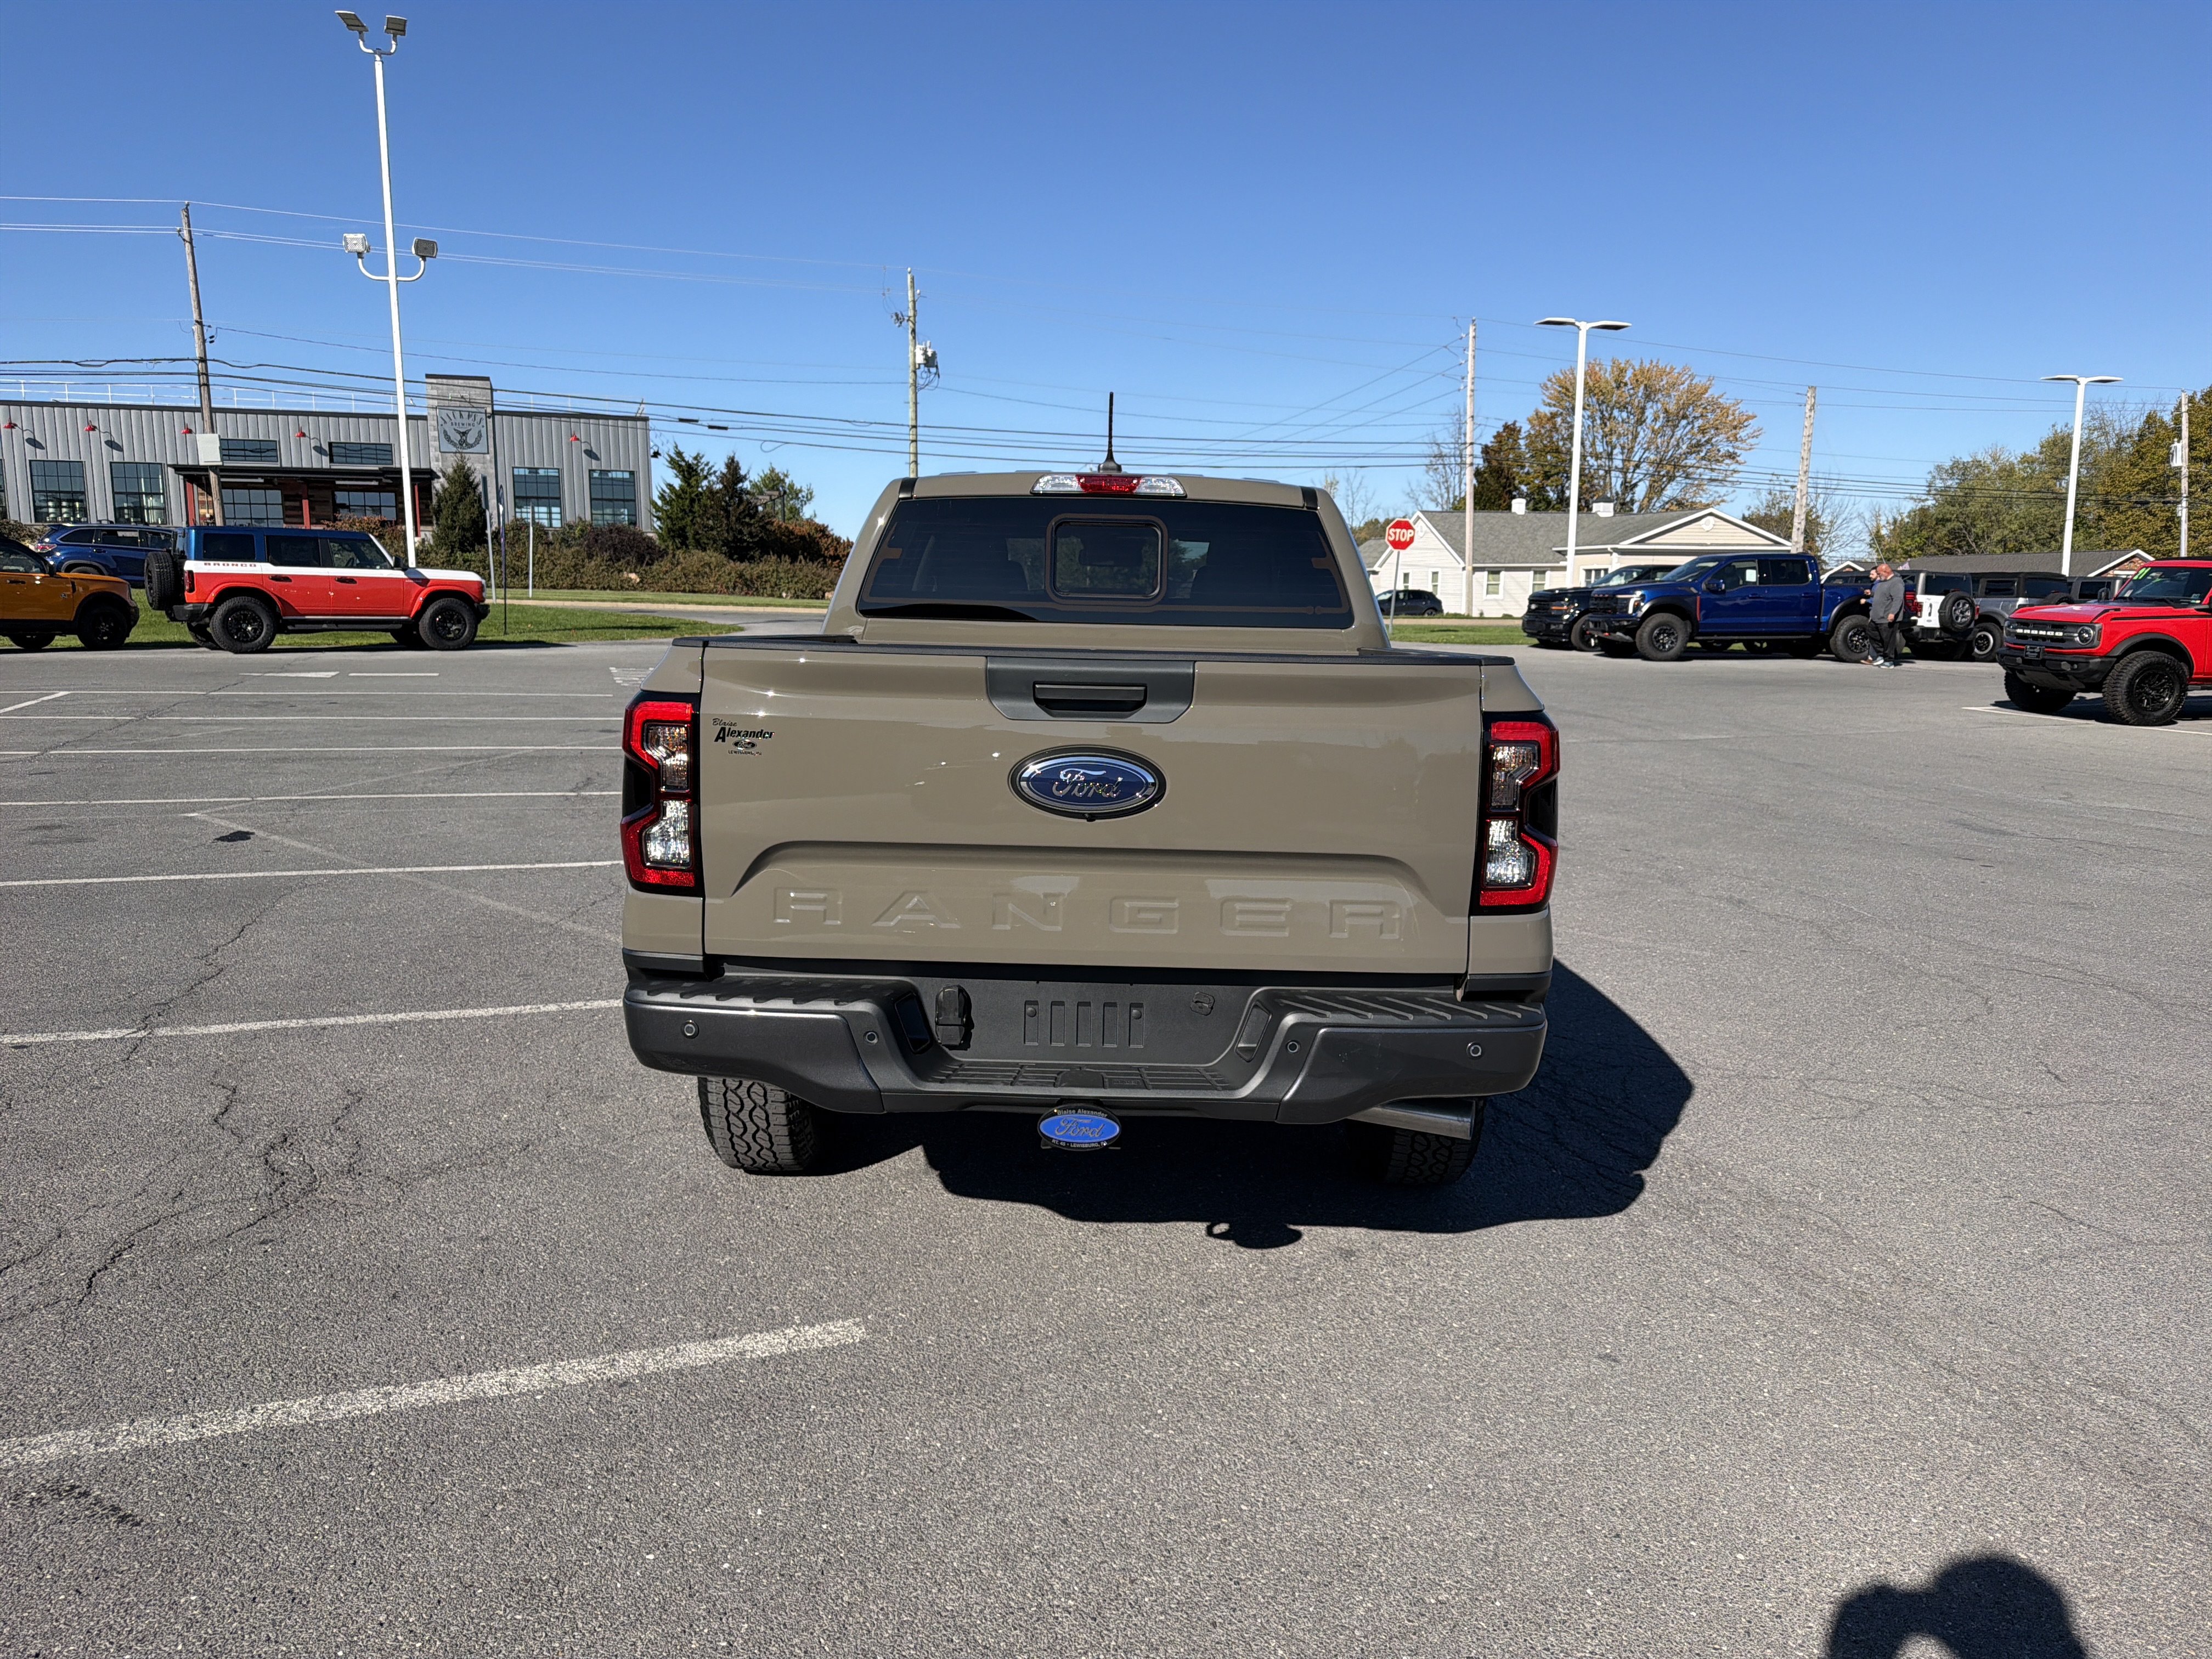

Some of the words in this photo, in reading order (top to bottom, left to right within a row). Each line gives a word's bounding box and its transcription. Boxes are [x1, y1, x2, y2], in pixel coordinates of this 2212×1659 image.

[1388, 528, 1414, 542] STOP
[2016, 628, 2063, 636] BRONCO
[712, 718, 738, 727] Blaise
[714, 726, 775, 743] Alexander
[1052, 768, 1124, 798] Ford
[773, 886, 1402, 939] RANGER
[1077, 1108, 1108, 1118] Alexander
[1054, 1118, 1105, 1137] Ford
